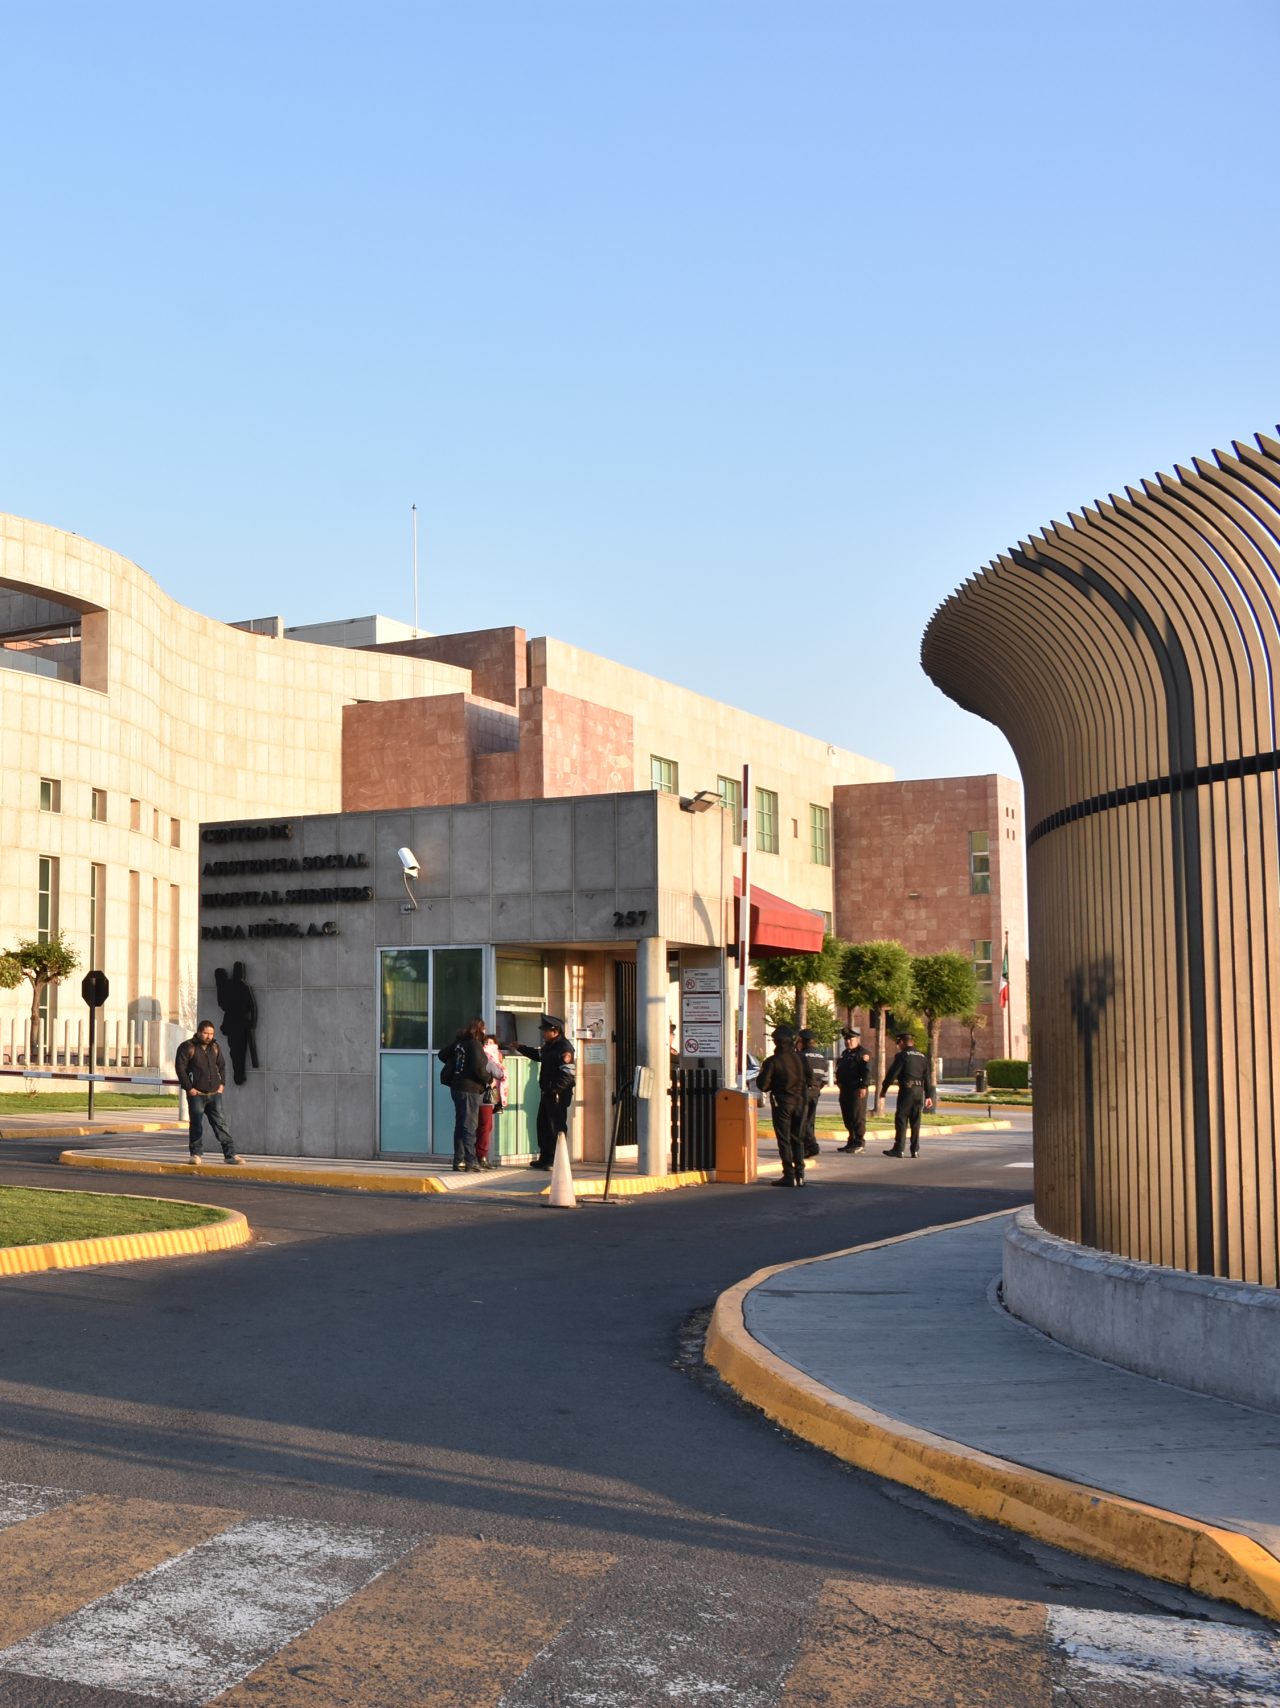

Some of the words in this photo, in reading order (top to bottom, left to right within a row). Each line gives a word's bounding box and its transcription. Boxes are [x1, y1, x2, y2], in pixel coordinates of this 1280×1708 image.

[202, 826, 268, 843] CENTRO
[269, 824, 293, 839] DE
[202, 858, 300, 876] ASISTENCIA
[302, 853, 369, 871] SOCIAL
[202, 890, 282, 907] HOSPITAL
[285, 886, 375, 904] SHRINERS
[613, 911, 648, 927] 257
[201, 925, 246, 940] PARA
[305, 921, 340, 937] A.C.
